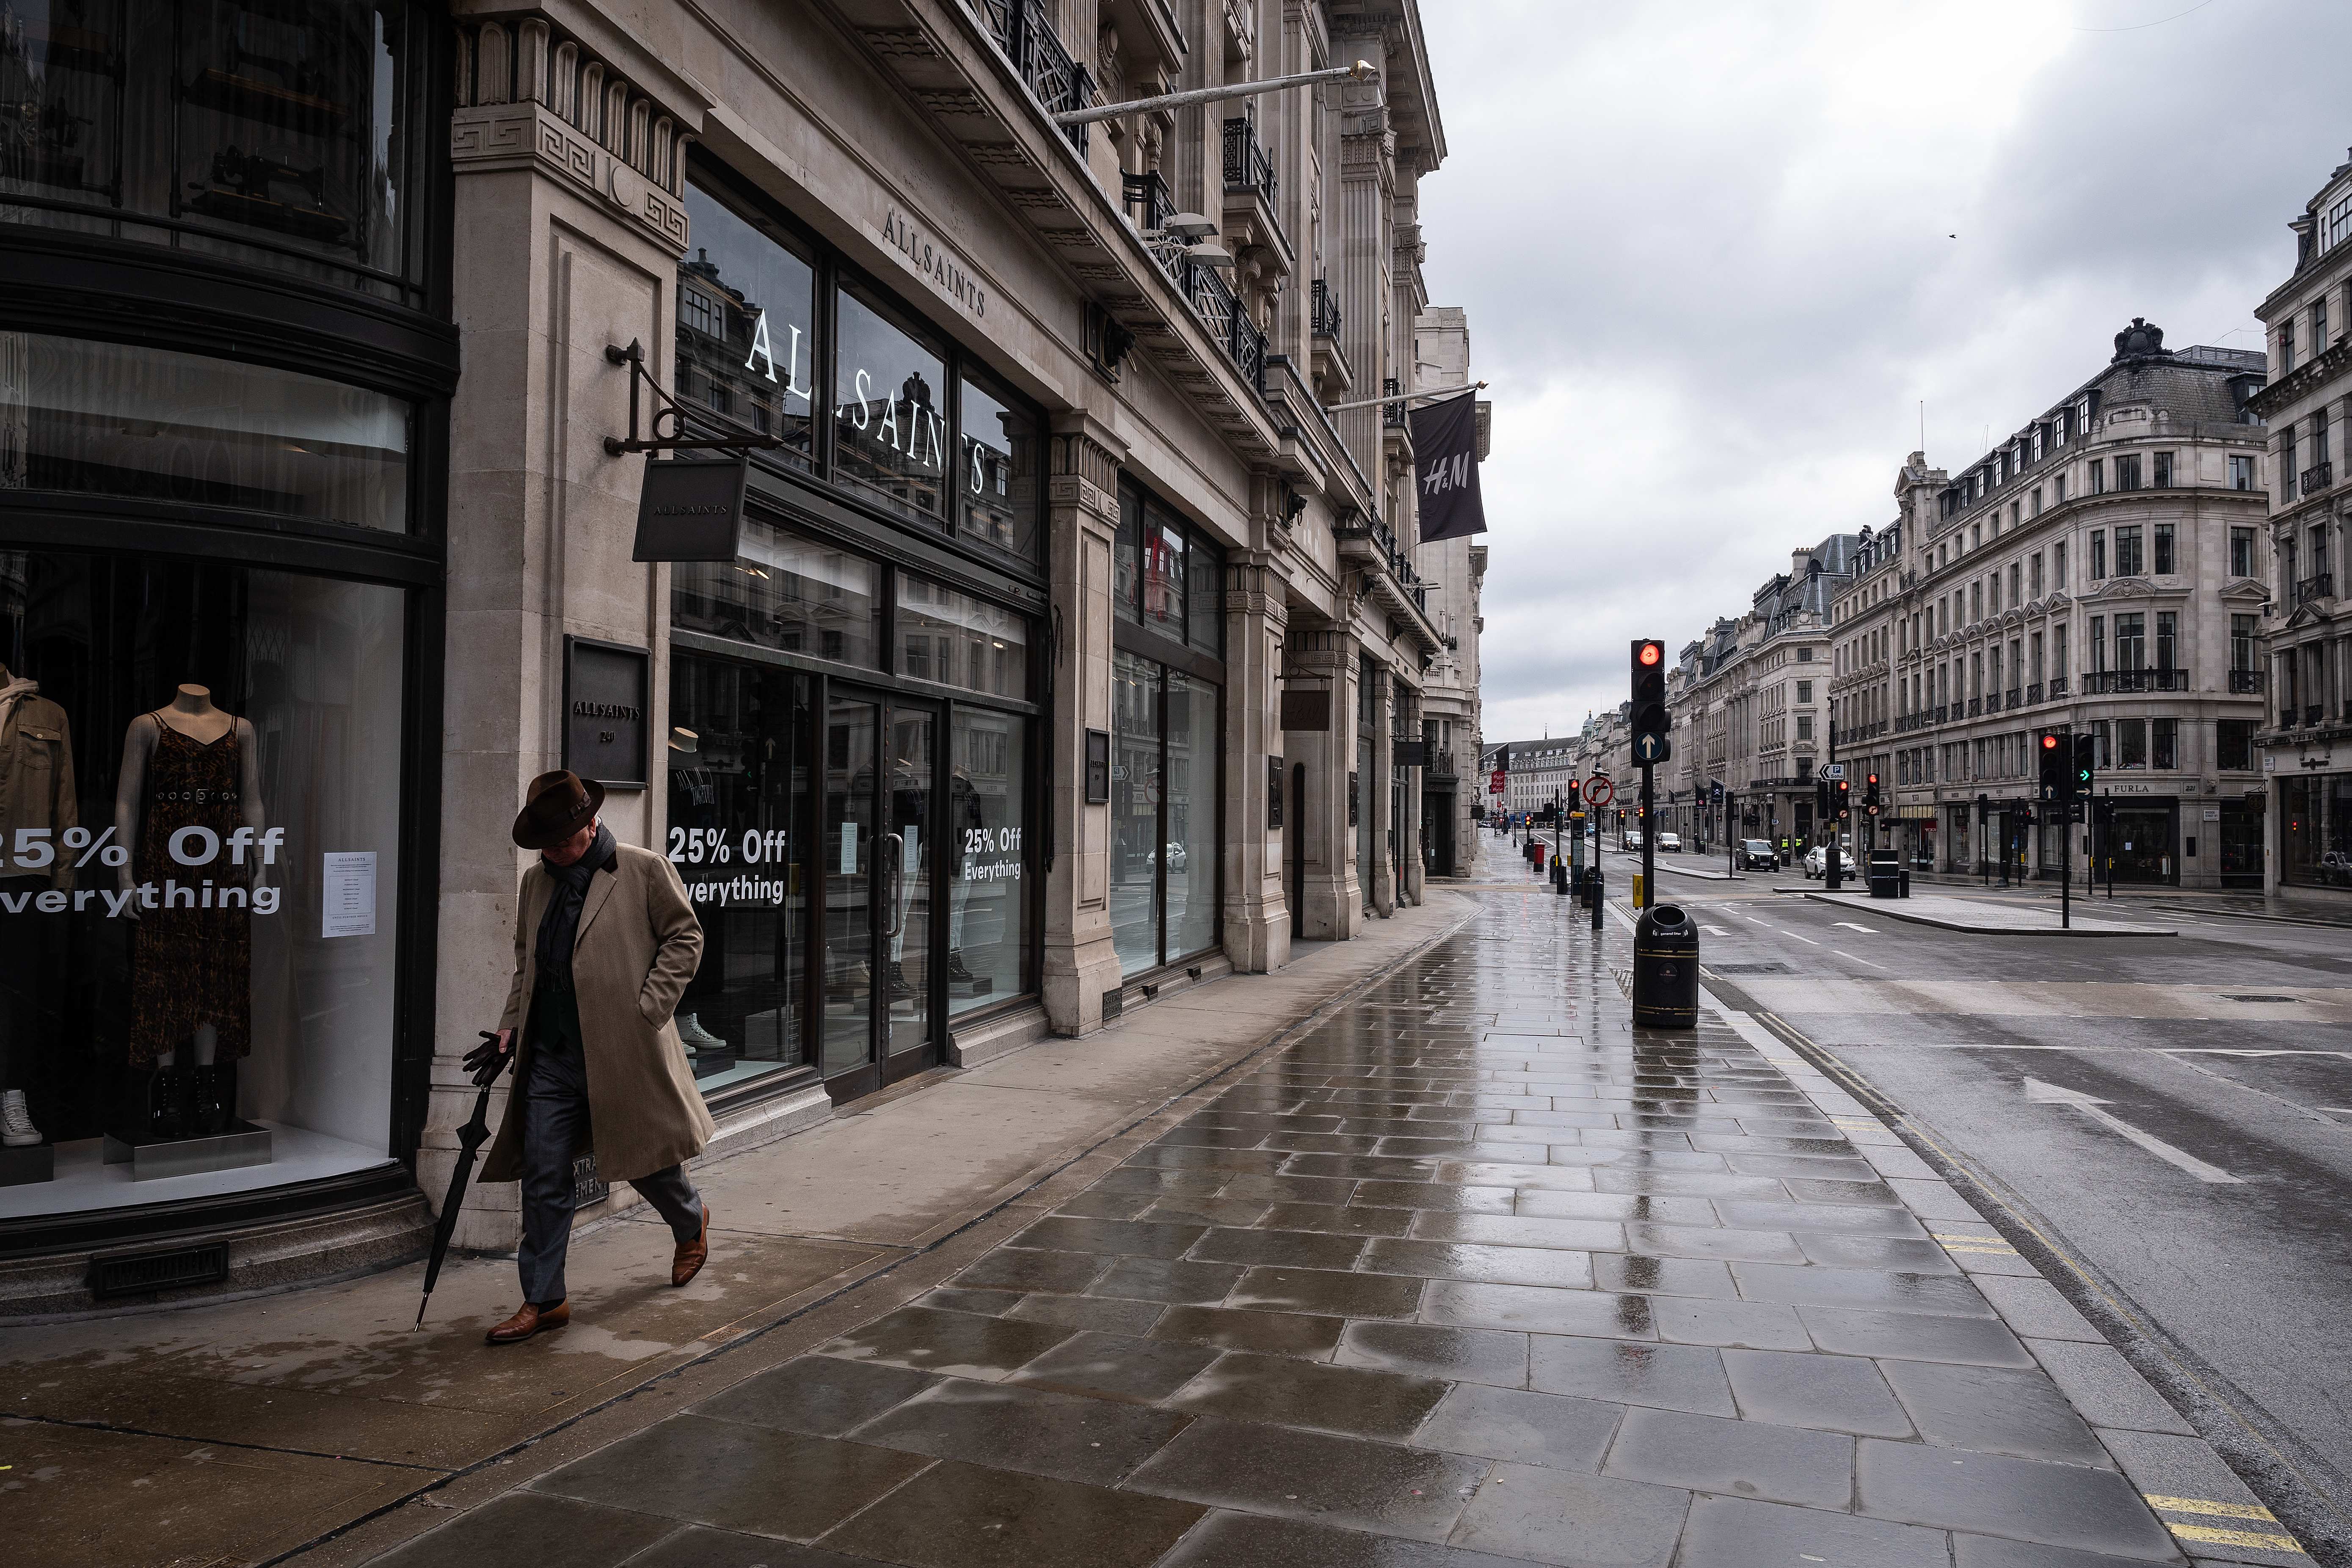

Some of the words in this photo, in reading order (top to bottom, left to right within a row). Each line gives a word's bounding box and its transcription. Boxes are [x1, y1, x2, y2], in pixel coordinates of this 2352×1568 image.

[883, 211, 984, 318] ALLSAINTS
[745, 308, 984, 494] ALSAINS
[1423, 451, 1470, 495] H&M
[654, 505, 727, 514] ALLSAINTS
[574, 700, 640, 719] ALLSAINTS
[0, 826, 128, 868] 5%
[168, 826, 284, 865] Off
[669, 827, 730, 863] 25%
[743, 829, 785, 863] Off
[965, 828, 994, 853] 25%
[1000, 827, 1021, 852] Off
[965, 859, 1021, 882] Everything
[0, 879, 280, 918] verything
[683, 875, 784, 907] verything
[573, 1155, 596, 1177] XTRA
